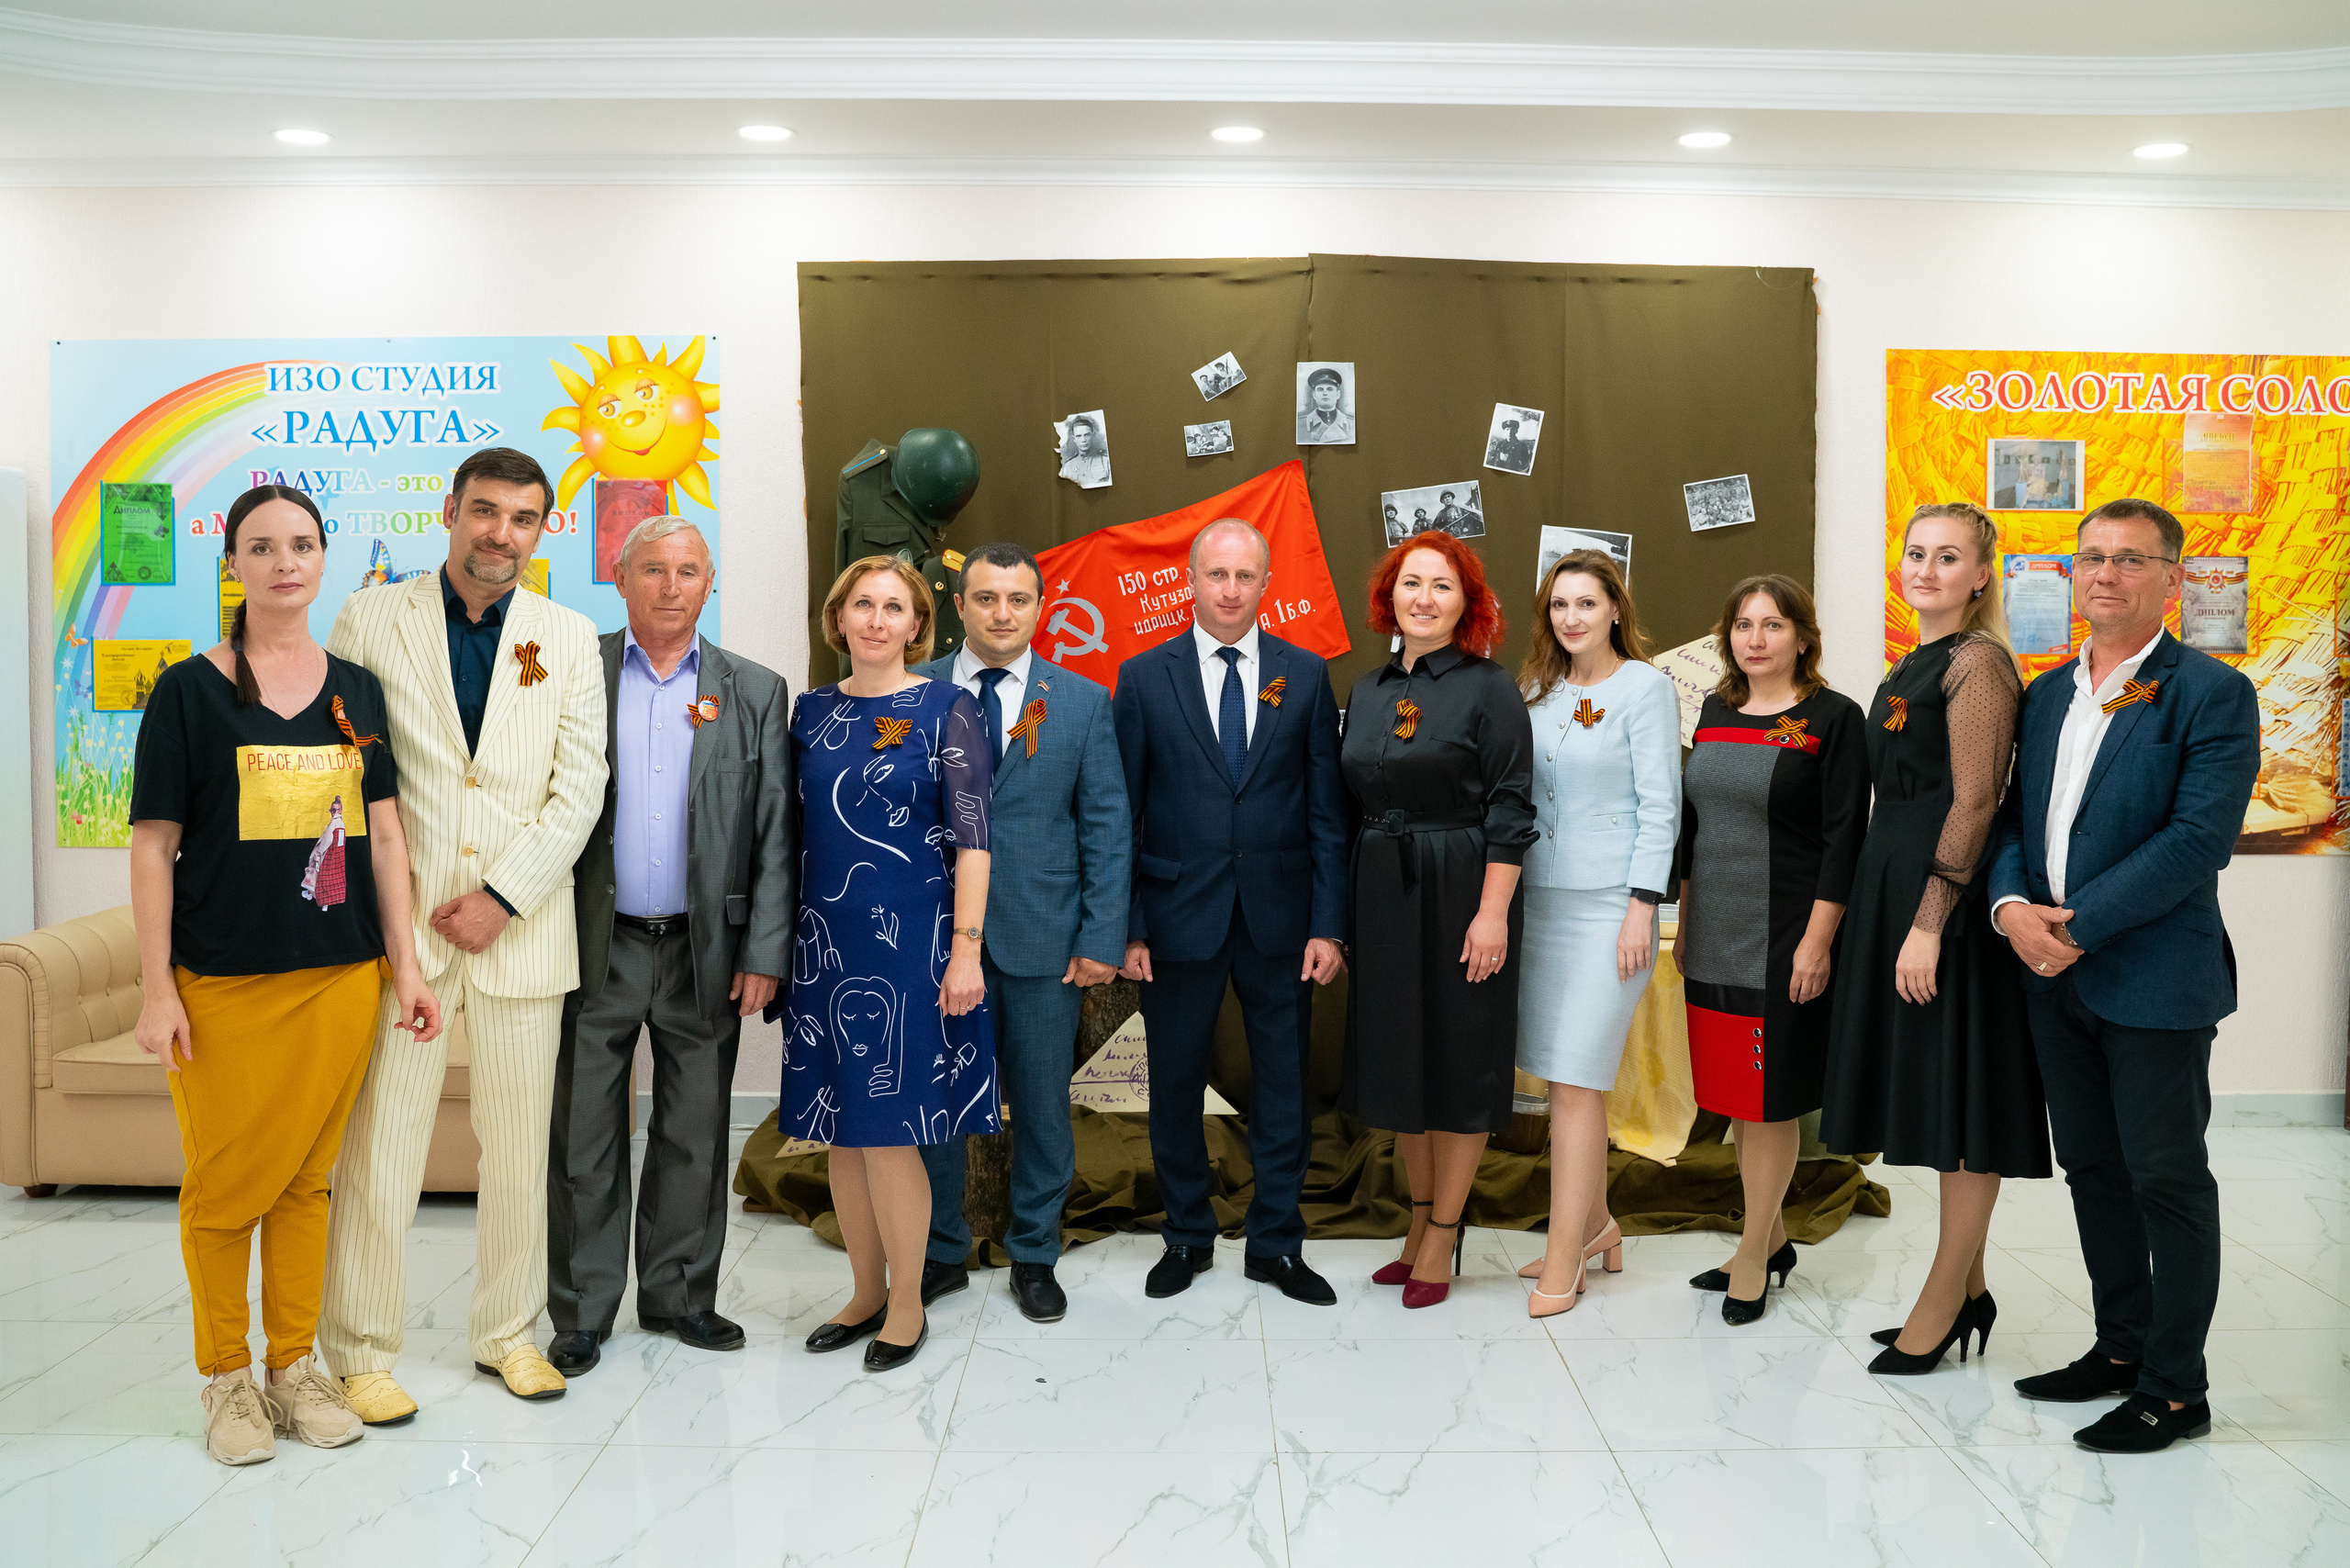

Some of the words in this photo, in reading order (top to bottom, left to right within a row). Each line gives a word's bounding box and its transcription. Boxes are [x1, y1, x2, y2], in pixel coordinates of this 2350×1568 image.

[268, 366, 341, 391] ИЗО
[352, 365, 498, 397] СТУДИЯ
[1934, 372, 2208, 412] «ЗОЛОТАЯ
[251, 409, 500, 453] «РАДУГА»
[250, 470, 374, 497] РАДУГА
[397, 476, 442, 491] это
[191, 519, 206, 535] а
[1117, 570, 1147, 597] 150
[1139, 586, 1195, 614] Кутузо
[247, 753, 294, 772] PEACE
[297, 754, 325, 771] AND
[328, 752, 362, 770] LOVE
